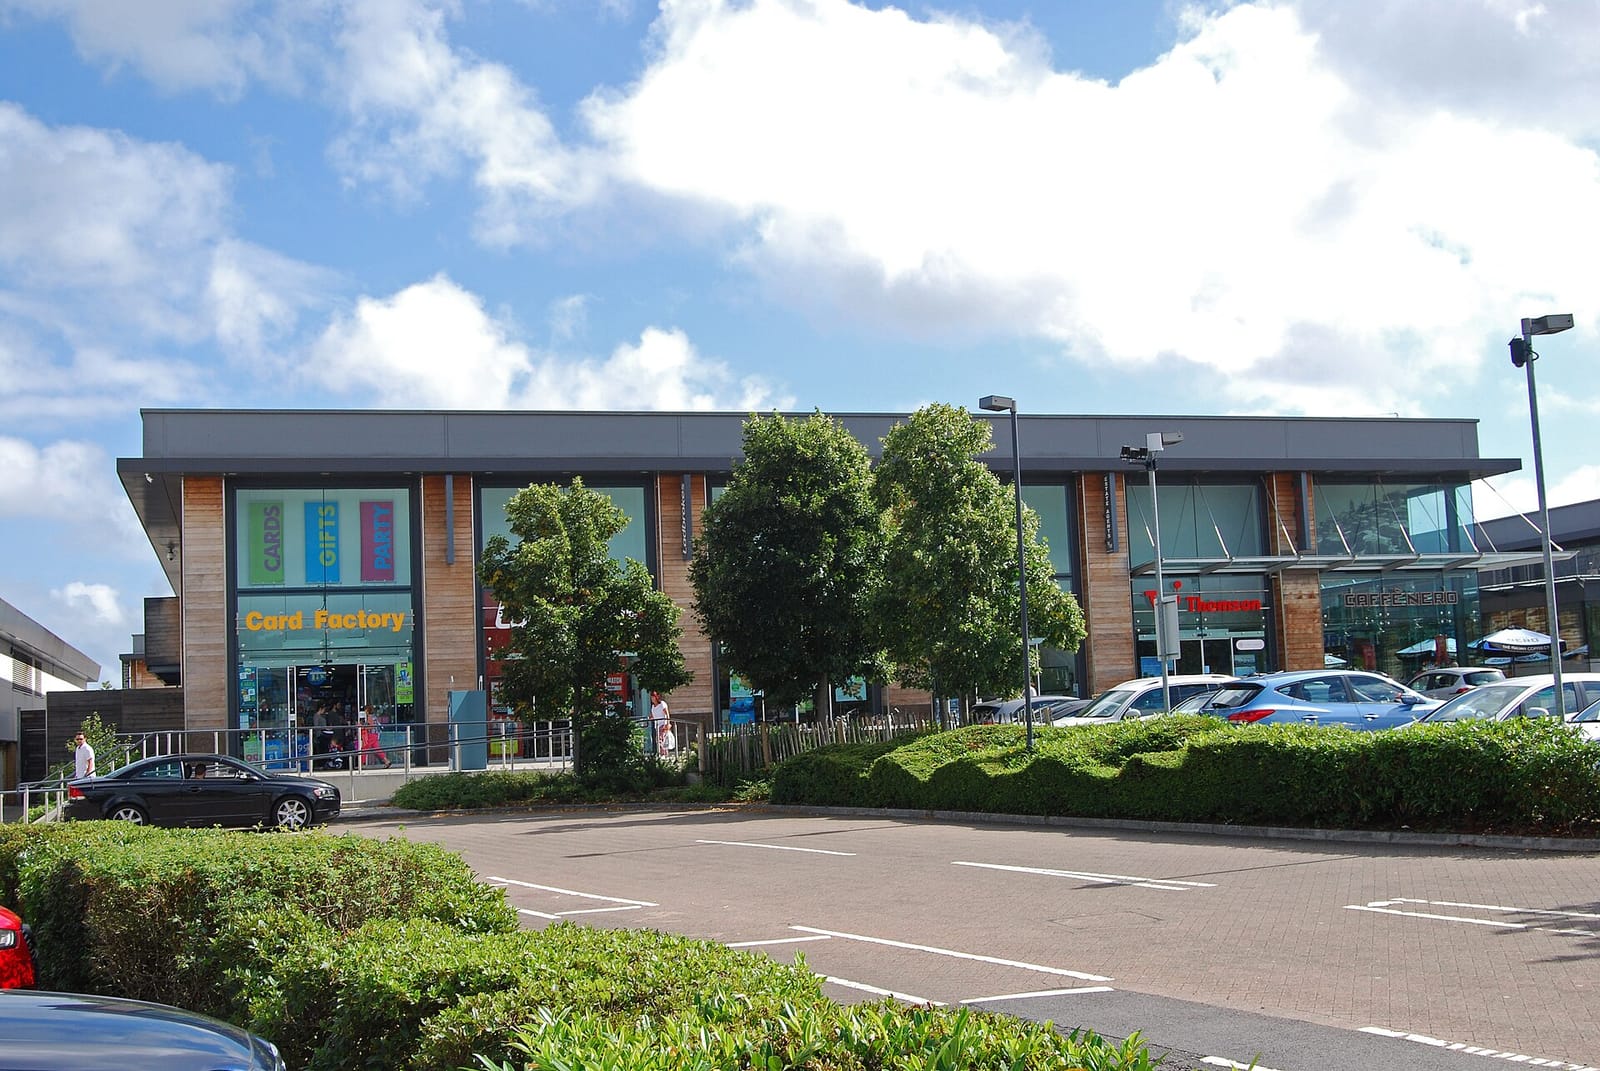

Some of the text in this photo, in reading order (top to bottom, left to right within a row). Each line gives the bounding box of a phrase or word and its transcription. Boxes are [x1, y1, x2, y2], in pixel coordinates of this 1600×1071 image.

[264, 505, 281, 572] CARDS
[318, 505, 336, 567] GIFTS
[372, 504, 392, 570] PARTY
[246, 609, 405, 632] Card Factory
[1185, 596, 1261, 612] Thomson
